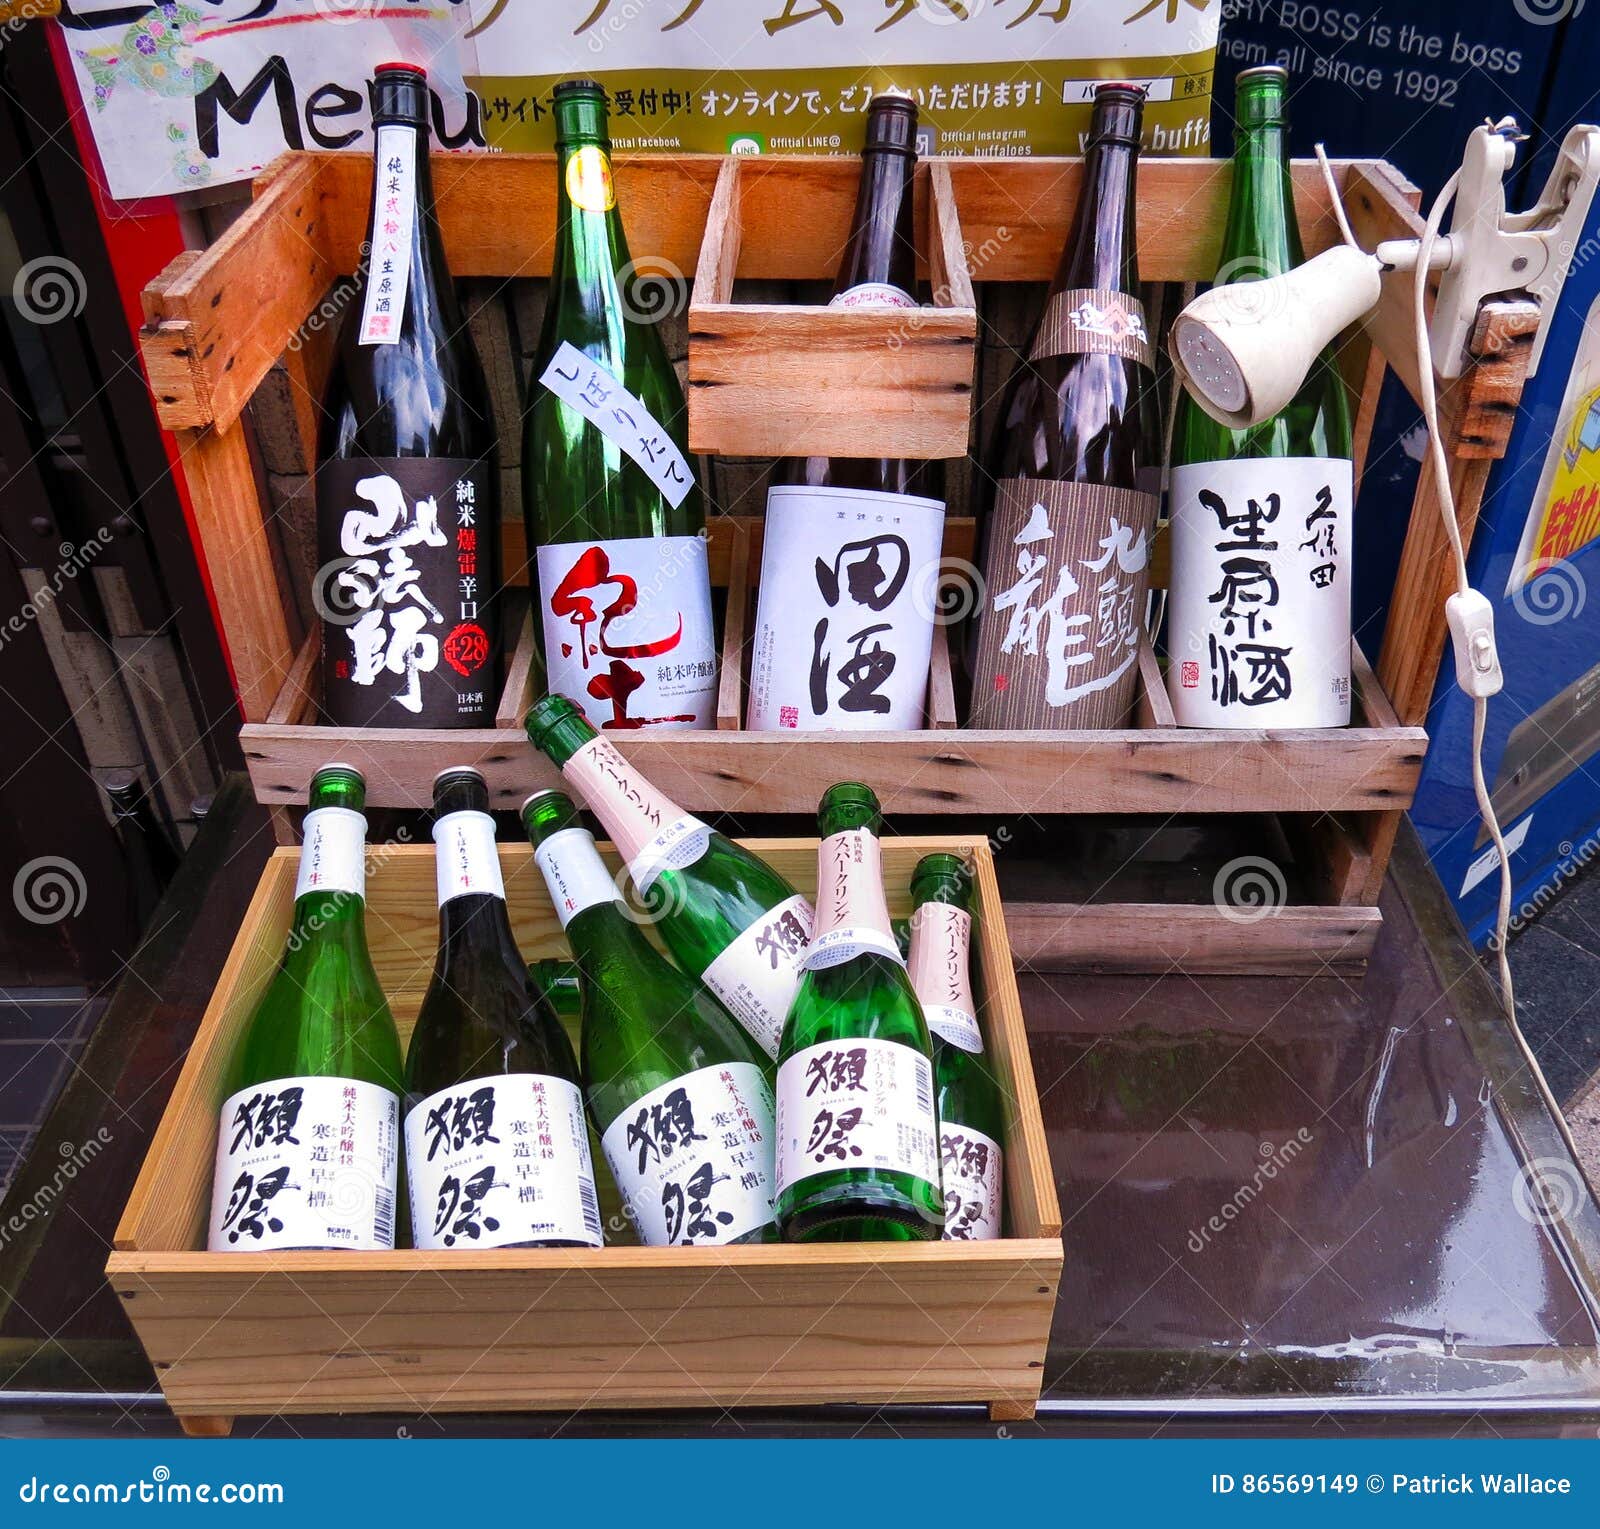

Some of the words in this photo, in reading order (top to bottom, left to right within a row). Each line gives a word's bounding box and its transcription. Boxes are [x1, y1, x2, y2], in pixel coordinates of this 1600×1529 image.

[1275, 46, 1306, 73] all
[1313, 52, 1383, 91] since
[1392, 69, 1460, 108] 1992
[1279, 0, 1361, 41] BOSS
[1368, 17, 1391, 48] is
[1399, 22, 1443, 60] the
[1450, 33, 1522, 76] boss
[638, 136, 681, 148] facebook
[807, 135, 841, 147] LINE@
[978, 129, 1027, 142] Instagram
[554, 366, 685, 484] しぼりたて
[456, 479, 478, 621] 純米爆雷辛口
[809, 533, 911, 716] 田酒
[457, 691, 484, 705] 日本酒
[586, 746, 661, 828] スパークリング
[833, 835, 850, 927] スパークリング
[945, 910, 962, 1002] スパークリング
